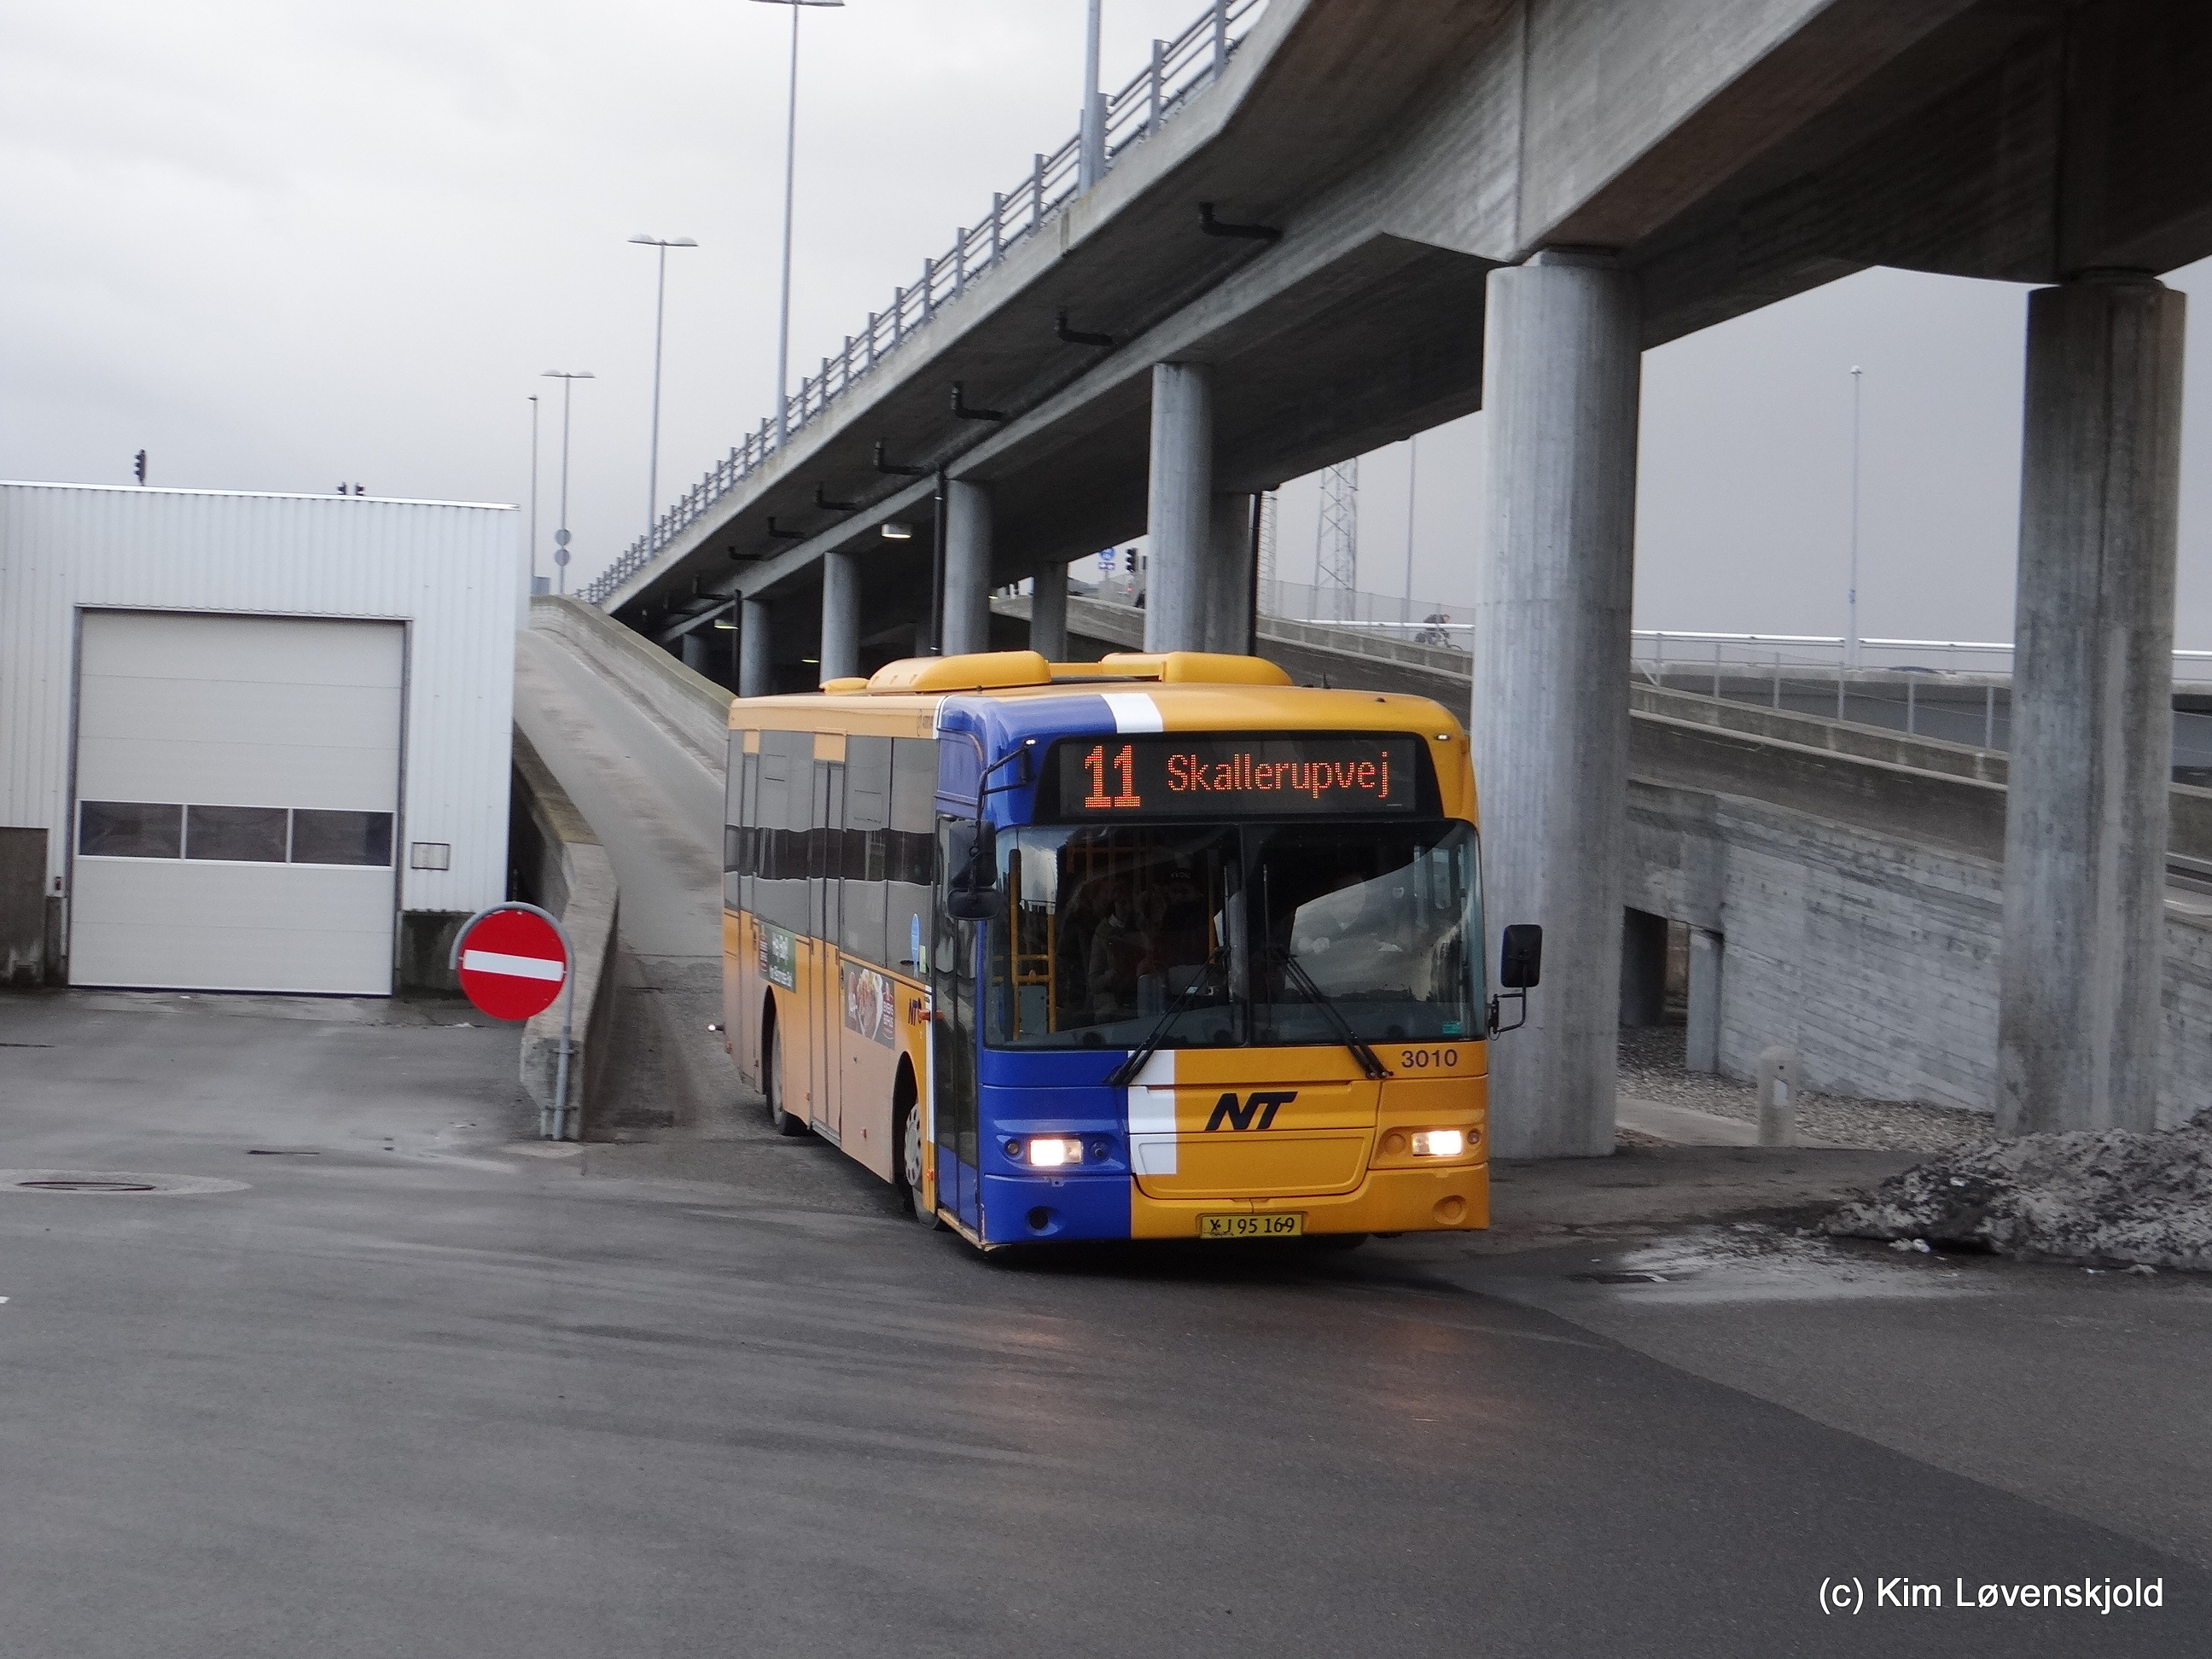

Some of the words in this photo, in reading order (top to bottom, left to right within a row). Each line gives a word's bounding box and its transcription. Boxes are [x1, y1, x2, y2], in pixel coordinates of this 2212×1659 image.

[1083, 745, 1142, 808] 11
[1167, 751, 1391, 799] Skallerupvej
[1400, 1048, 1458, 1068] 3010
[1204, 1091, 1298, 1131] NT
[1237, 1218, 1258, 1234] 95
[1264, 1217, 1295, 1233] 169
